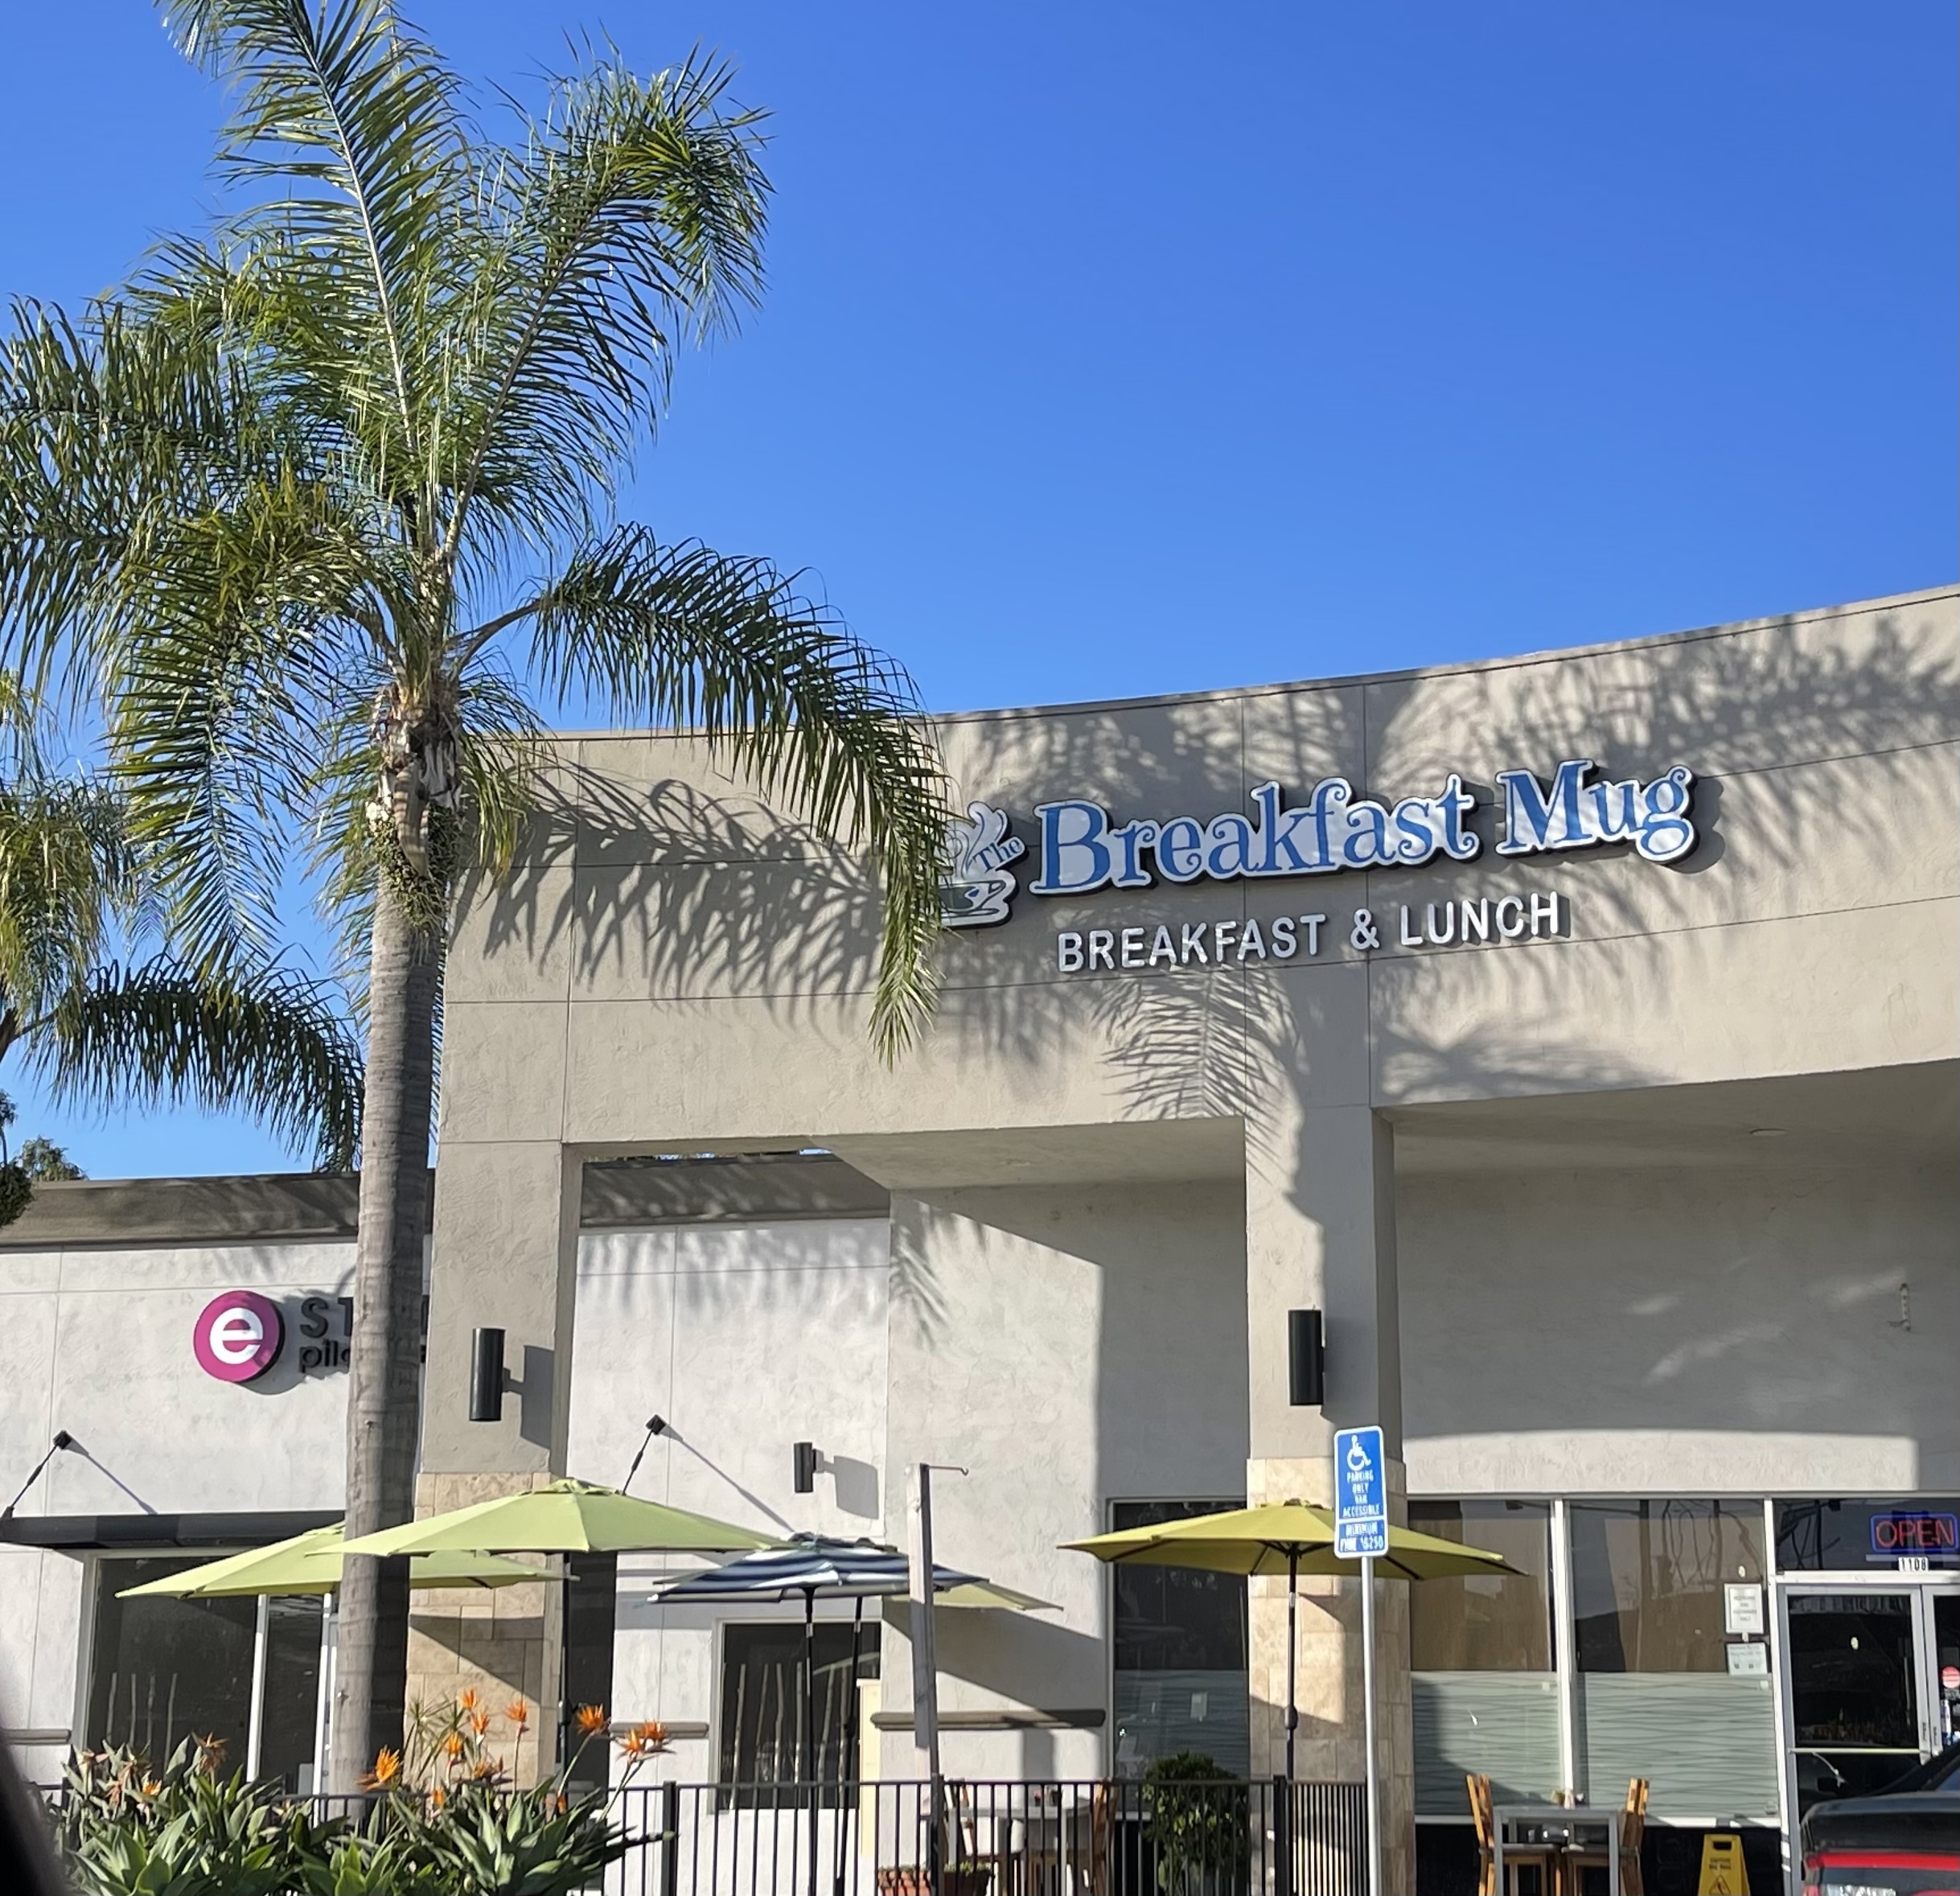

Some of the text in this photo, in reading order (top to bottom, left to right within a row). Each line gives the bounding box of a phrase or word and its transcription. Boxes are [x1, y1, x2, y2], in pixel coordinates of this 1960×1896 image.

[972, 760, 1690, 890] The Breakfast Mug
[1058, 891, 1559, 972] BREAKFAST & LUNCH
[209, 1307, 263, 1364] e
[1876, 1520, 1954, 1548] OPEN
